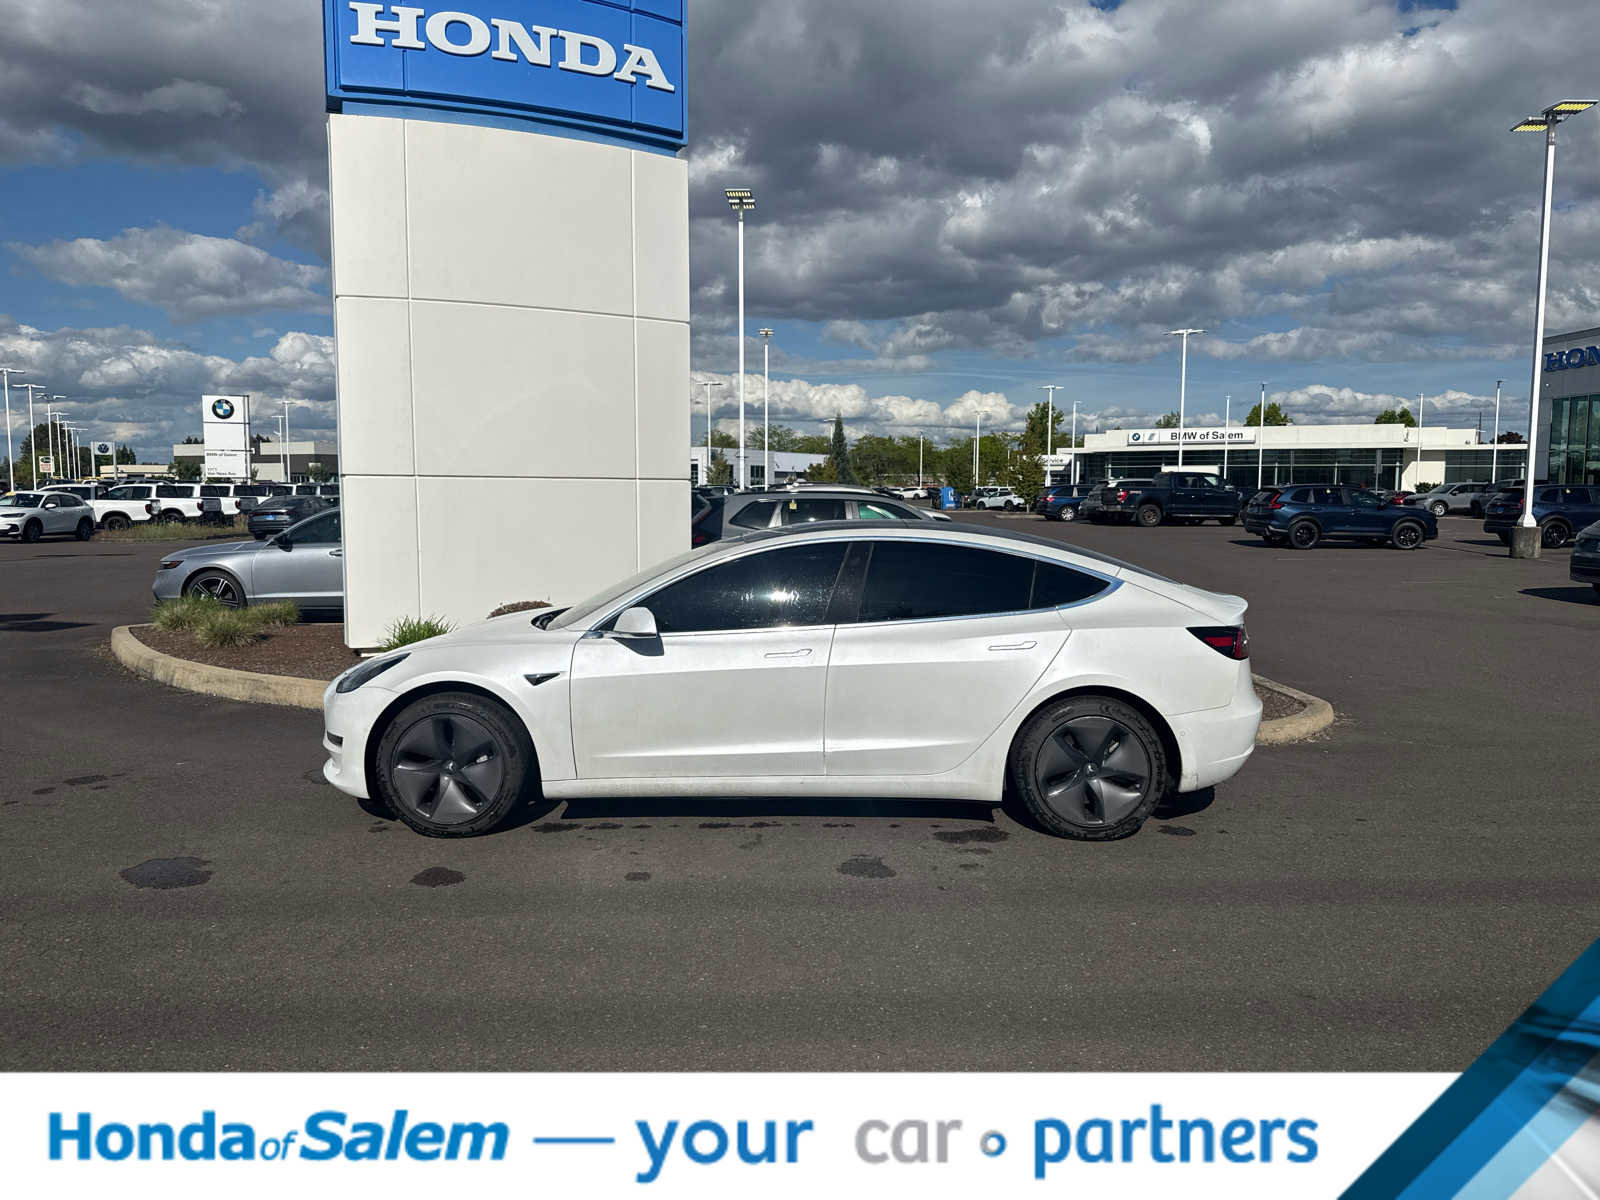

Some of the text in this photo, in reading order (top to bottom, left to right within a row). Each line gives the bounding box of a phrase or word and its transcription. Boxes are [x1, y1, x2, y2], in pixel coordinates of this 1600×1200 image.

[349, 2, 675, 92] HONDA
[1170, 431, 1243, 440] BMW of Saem
